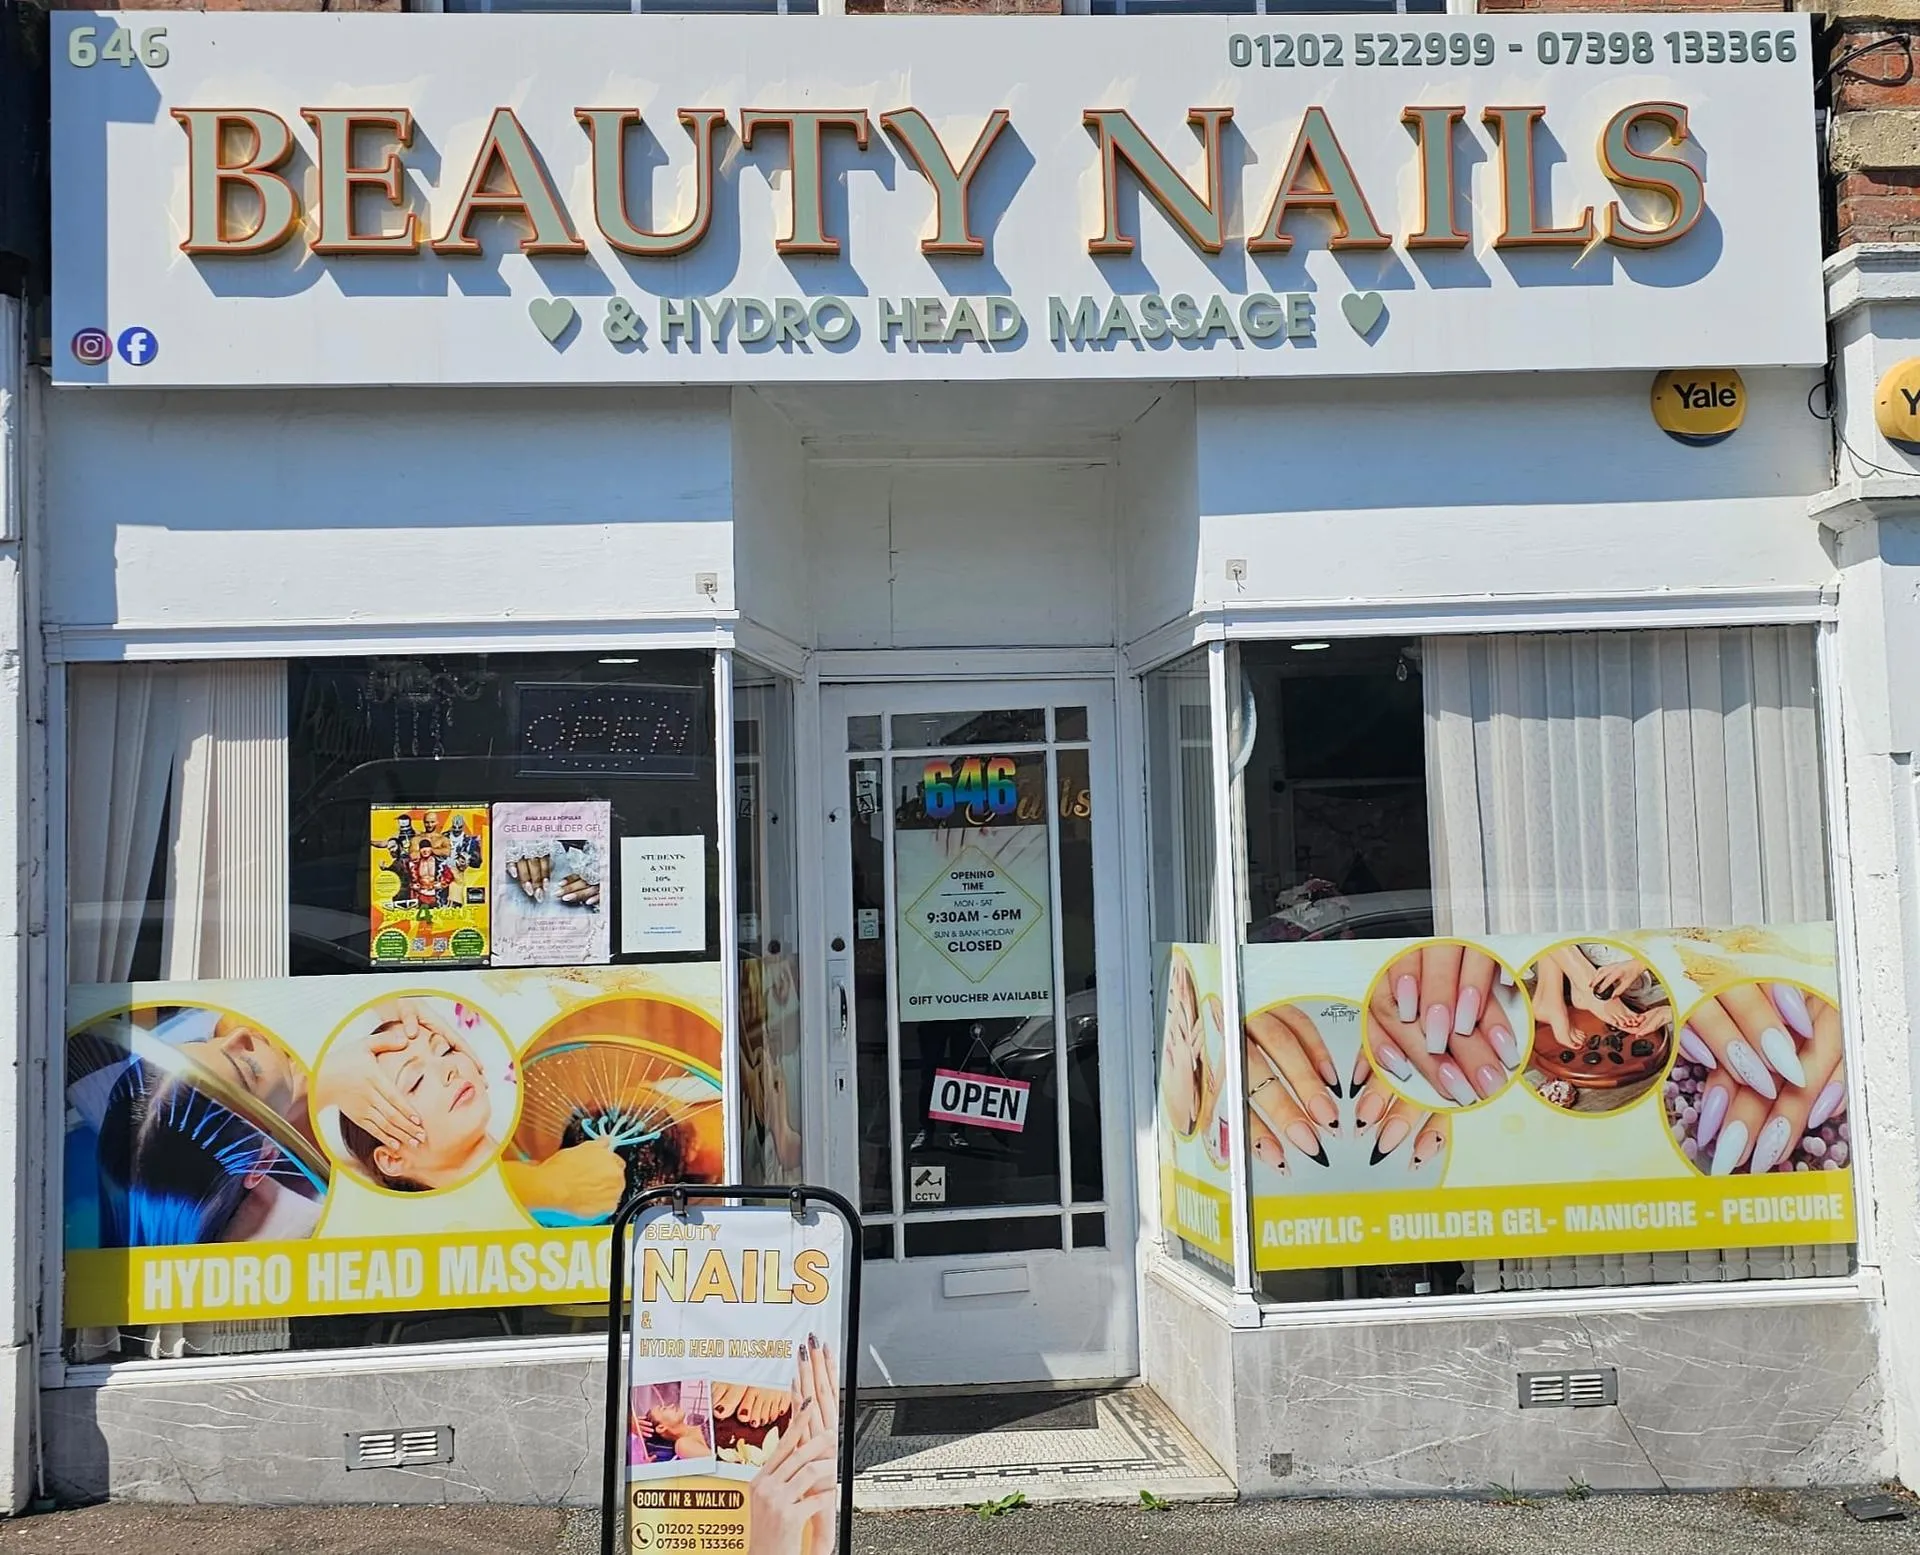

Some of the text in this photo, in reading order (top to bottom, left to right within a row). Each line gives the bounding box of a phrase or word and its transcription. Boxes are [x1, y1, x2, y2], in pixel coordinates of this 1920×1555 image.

[69, 26, 169, 69] 646
[1228, 33, 1344, 68] 01202
[1354, 32, 1495, 66] 522999
[1537, 31, 1655, 64] 07398
[1664, 29, 1797, 63] 133366
[169, 100, 1706, 257] BEAUTY NAILS
[603, 292, 1312, 343] & HYDRO HEAD MASSAGE
[1673, 381, 1737, 409] Yale
[525, 714, 690, 755] OPEN
[923, 756, 1018, 819] 646
[544, 823, 583, 833] BUILDER
[585, 822, 603, 832] GEL
[950, 870, 995, 880] OPENING
[962, 882, 985, 891] TIME
[953, 900, 975, 908] MON
[980, 899, 993, 907] SAT
[926, 910, 980, 924] 9:30AM
[991, 908, 1022, 921] 6PM
[934, 927, 1015, 939] SUN & BANK HOLIDAY
[947, 939, 1003, 953] CLOSED
[909, 990, 1049, 1006] GIFT VOUCHER AVAILABLE
[940, 1080, 1021, 1121] OPEN
[915, 1192, 941, 1201] CCTV
[1261, 1216, 1365, 1248] ACRYLIC
[1388, 1210, 1494, 1241] BUILDER
[1564, 1200, 1698, 1232] MANICURE
[1721, 1193, 1845, 1225] PEDICURE
[644, 1223, 721, 1241] BEAUTY
[143, 1253, 291, 1311] HYDRO
[307, 1247, 424, 1303] HEAD
[642, 1248, 830, 1305] NAILS
[640, 1310, 652, 1329] &
[640, 1338, 793, 1359] HYDRO HEAD MASSAGE
[636, 1491, 740, 1508] BOOK IN & WALK IN
[656, 1523, 745, 1535] 01202 522999
[656, 1538, 745, 1550] 07398 133366
